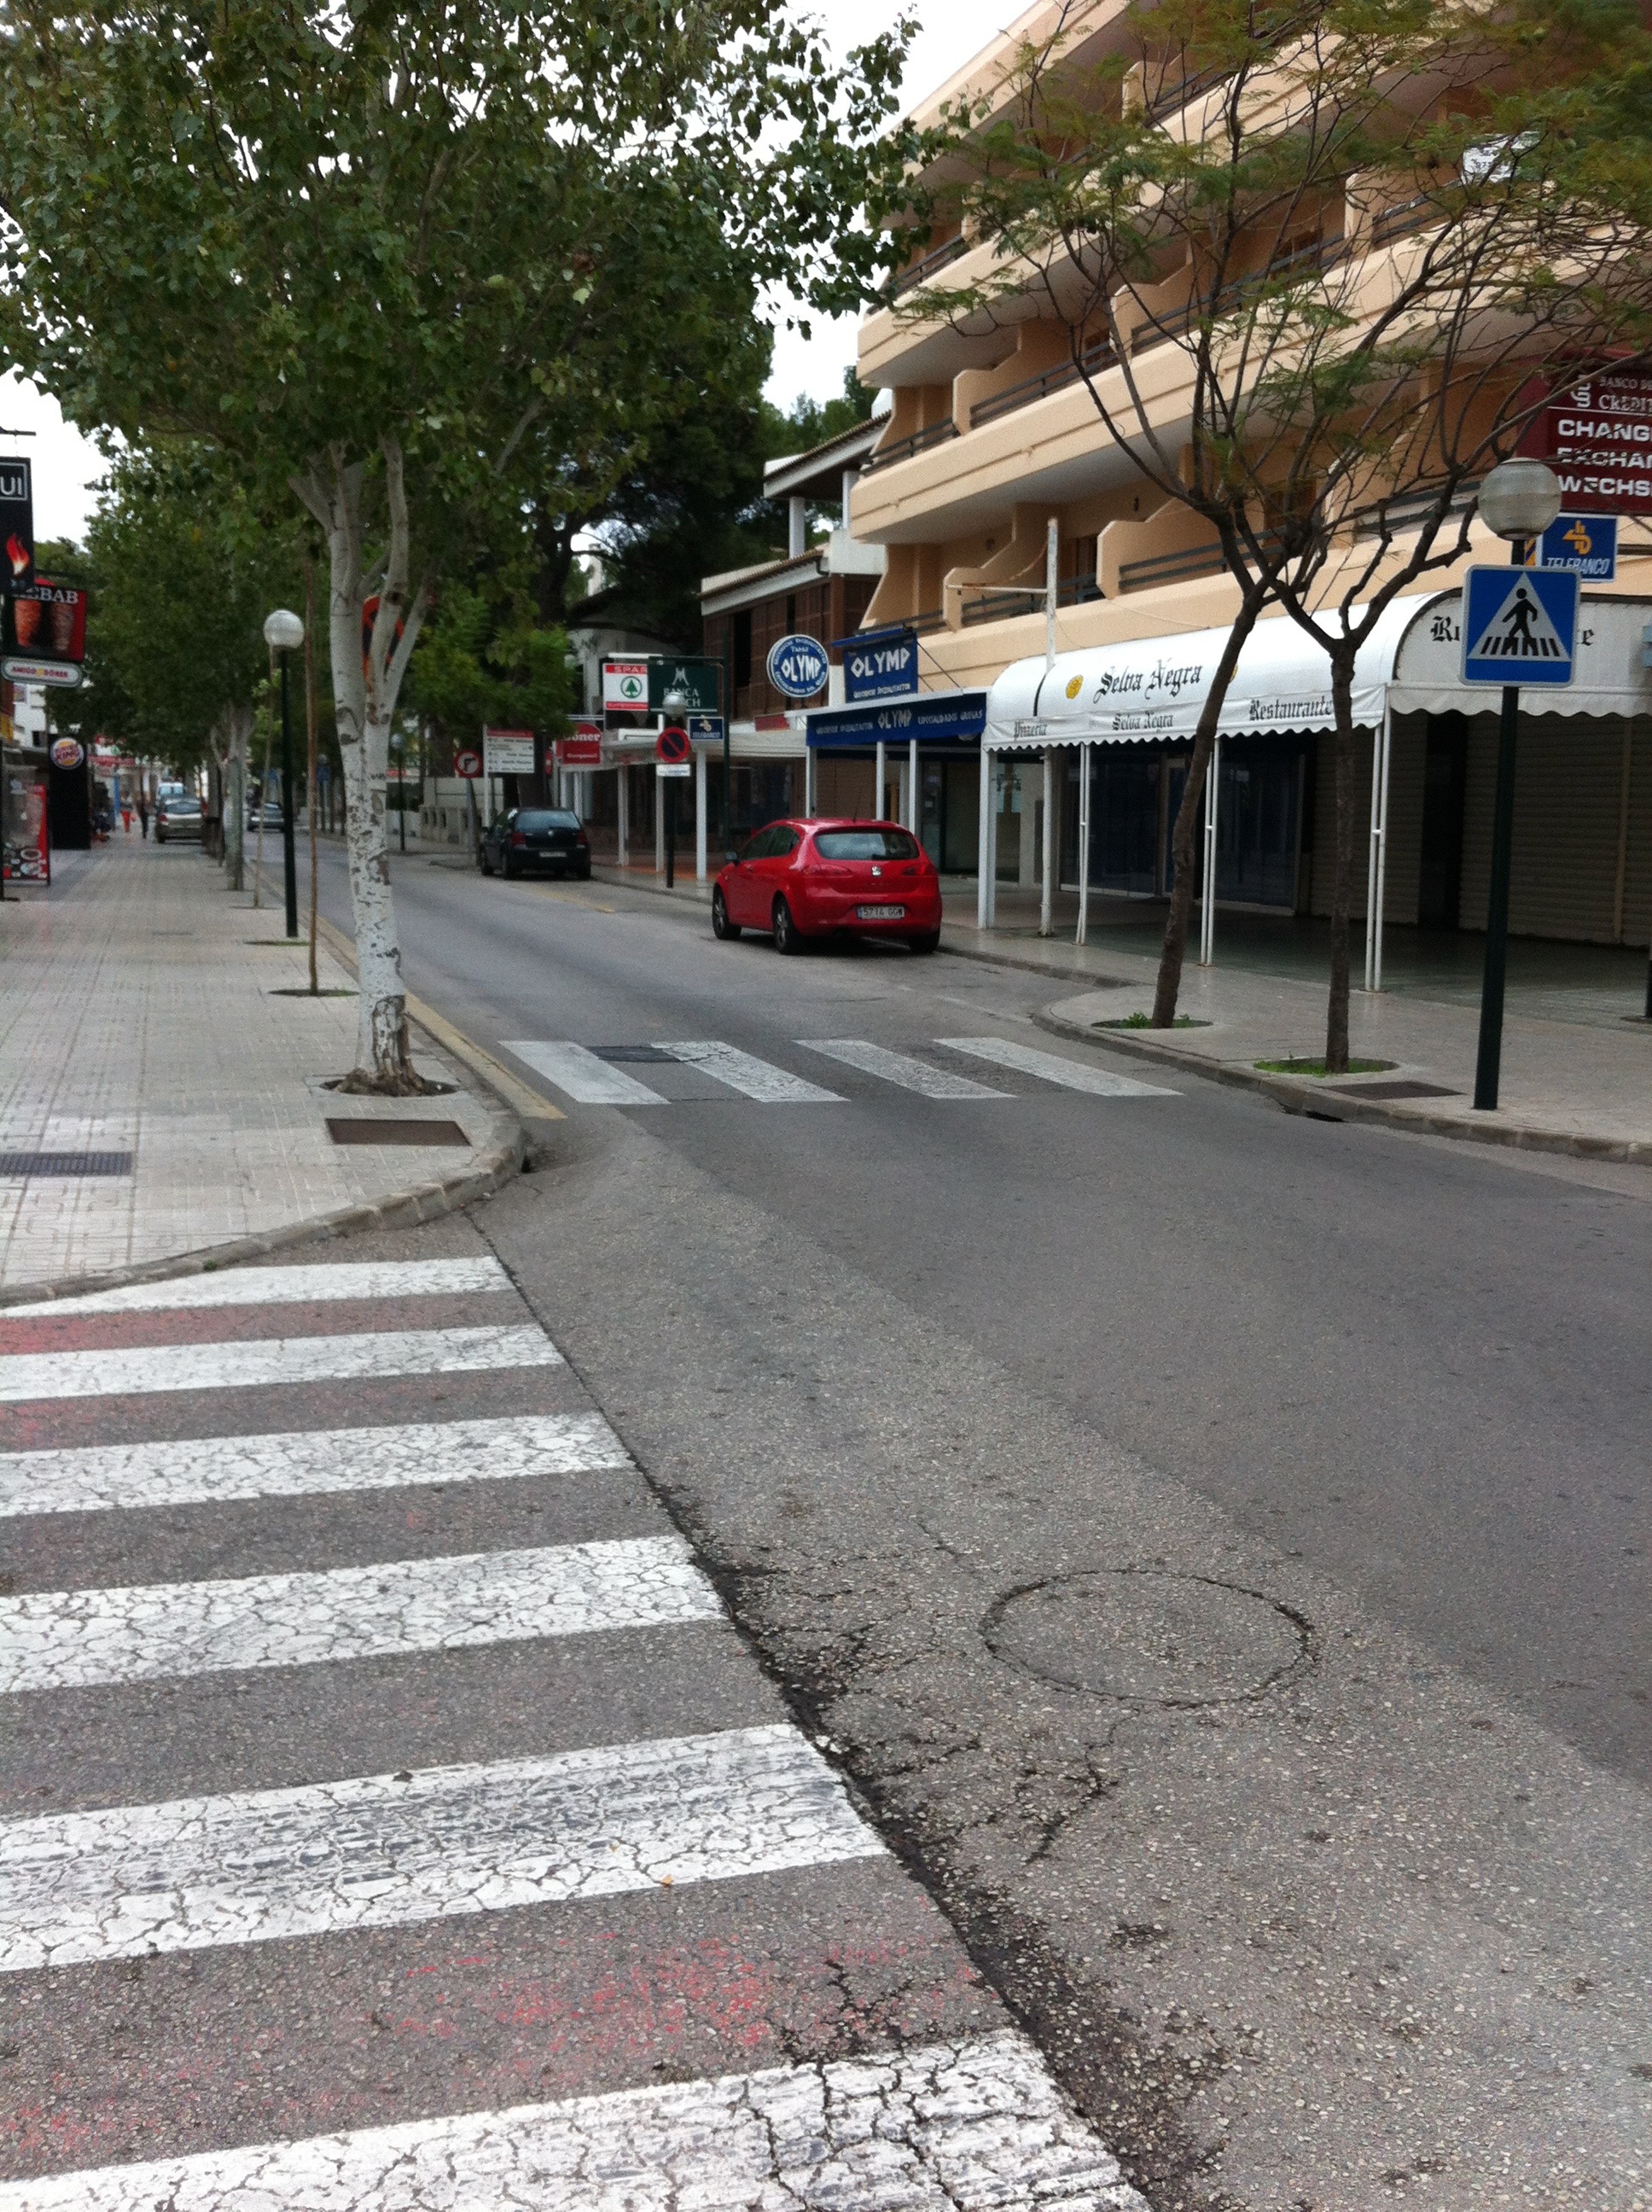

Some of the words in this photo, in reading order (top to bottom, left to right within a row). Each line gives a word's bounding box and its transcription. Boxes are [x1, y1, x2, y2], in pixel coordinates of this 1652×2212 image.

[1557, 418, 1652, 442] CHANG
[1557, 474, 1652, 497] WECHS
[781, 655, 822, 683] OLYMP
[850, 647, 910, 678] OLYMP
[1093, 665, 1143, 704] Selva
[1144, 657, 1203, 700] Negra
[877, 709, 912, 729] OLYMP
[1112, 713, 1141, 731] Selva
